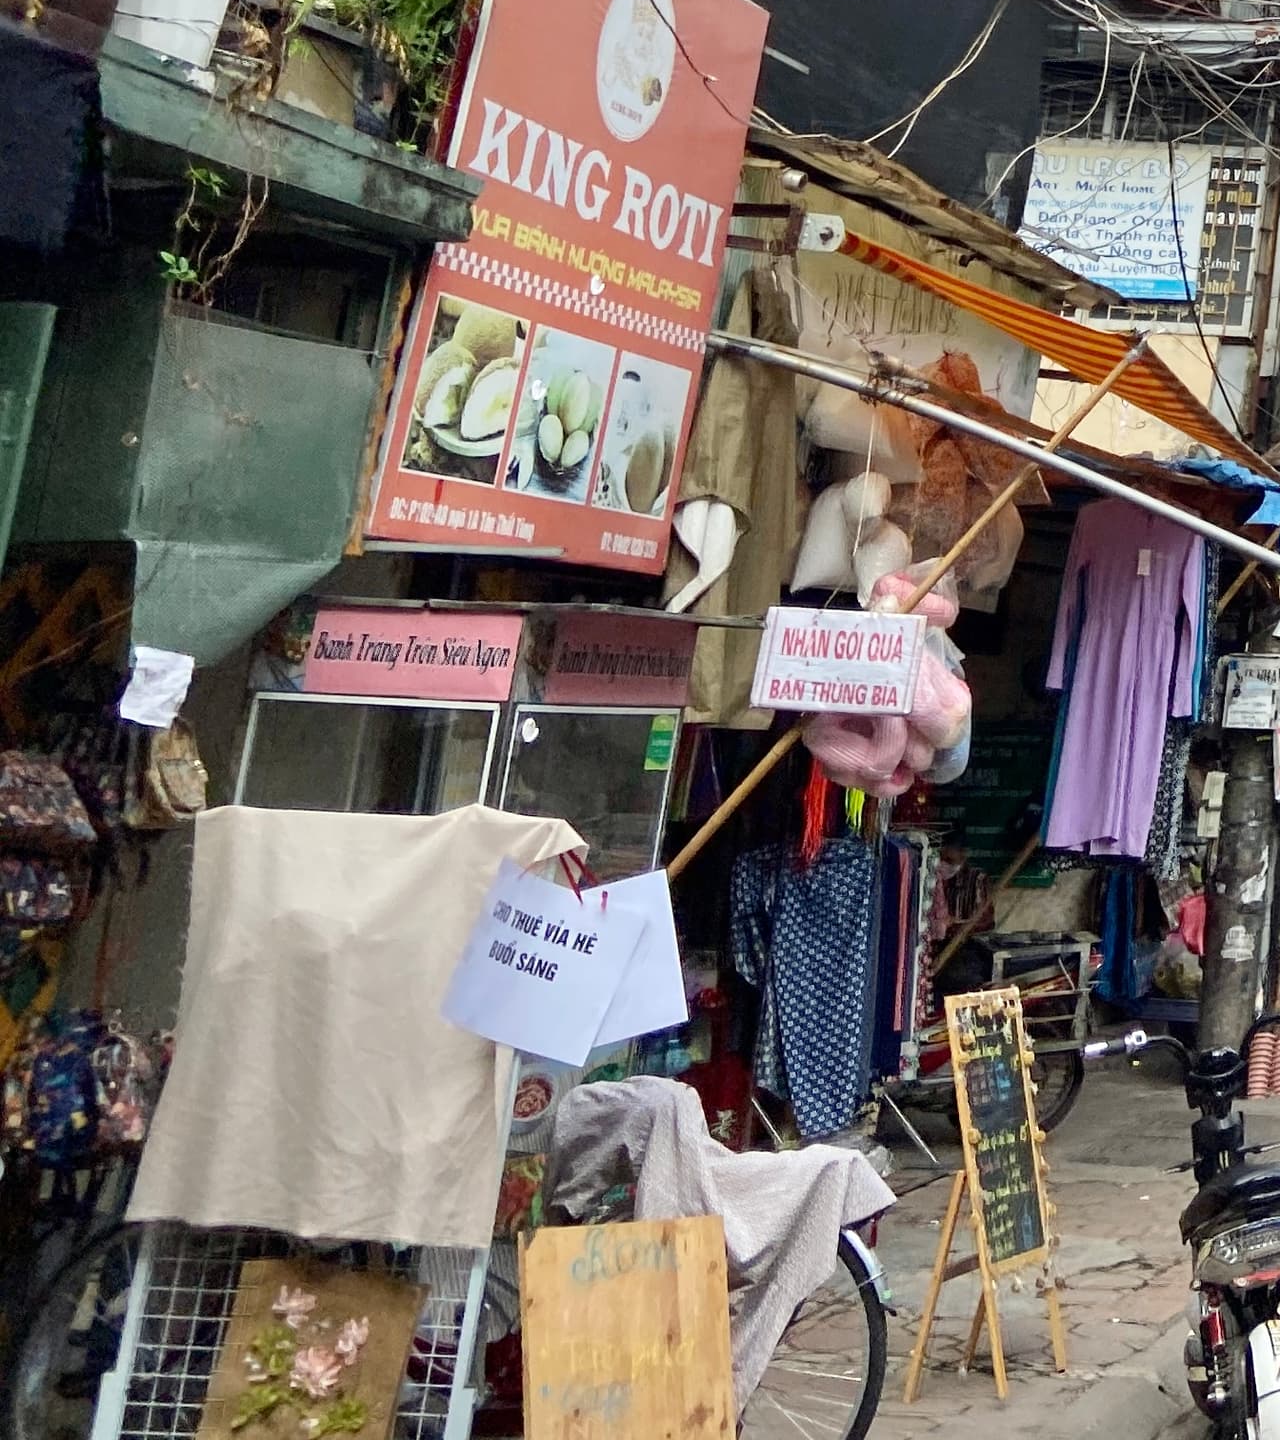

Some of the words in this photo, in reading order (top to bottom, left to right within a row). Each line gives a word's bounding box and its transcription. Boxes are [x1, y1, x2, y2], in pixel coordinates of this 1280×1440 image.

[469, 98, 611, 222] KING
[612, 165, 725, 267] ROTI
[1074, 212, 1117, 228] Piano
[513, 221, 567, 263] BÁNH
[626, 262, 703, 313] MALAYSIA
[834, 623, 864, 660] GÓI
[867, 626, 904, 663] QUÀ
[768, 672, 806, 701] BÁN
[510, 908, 543, 938] THUÊ
[543, 918, 571, 948] VỈA
[487, 938, 516, 968] BUỔI
[515, 951, 559, 982] SÁNG
